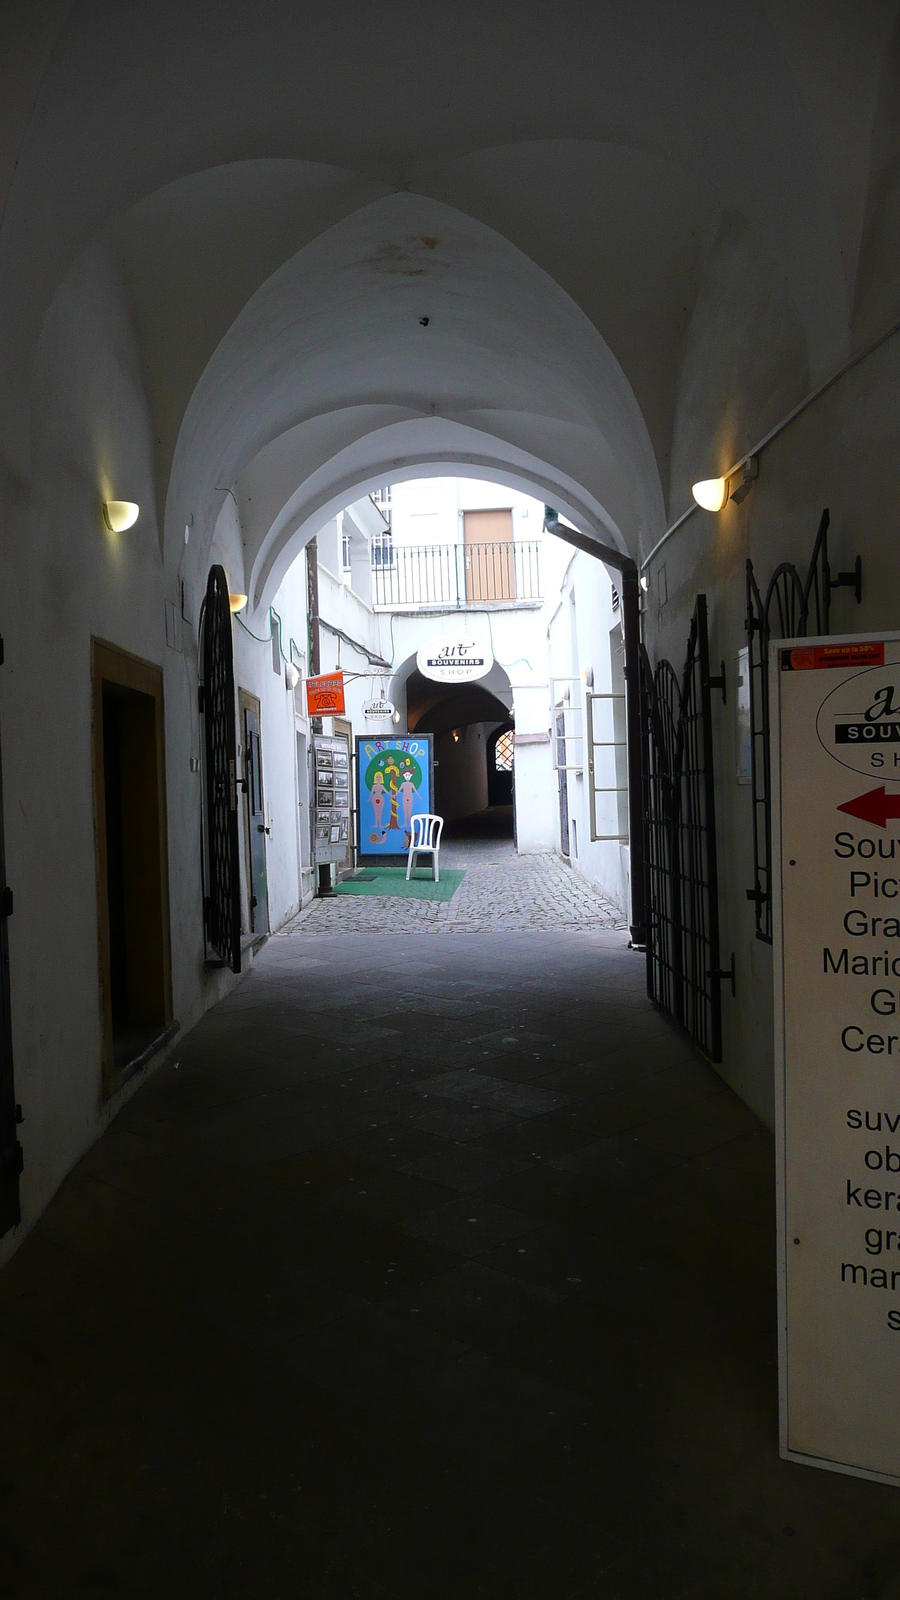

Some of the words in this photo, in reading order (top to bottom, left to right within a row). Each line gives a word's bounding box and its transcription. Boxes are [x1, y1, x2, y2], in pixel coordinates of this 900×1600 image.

[438, 642, 475, 659] art
[824, 647, 840, 655] Save
[864, 686, 900, 722] a
[364, 740, 390, 760] ART
[395, 740, 425, 758] SHOP
[834, 832, 900, 859] Sou
[850, 871, 900, 899] Pic
[842, 1025, 900, 1055] Cer
[847, 1180, 900, 1211] ker
[865, 1228, 900, 1255] gr
